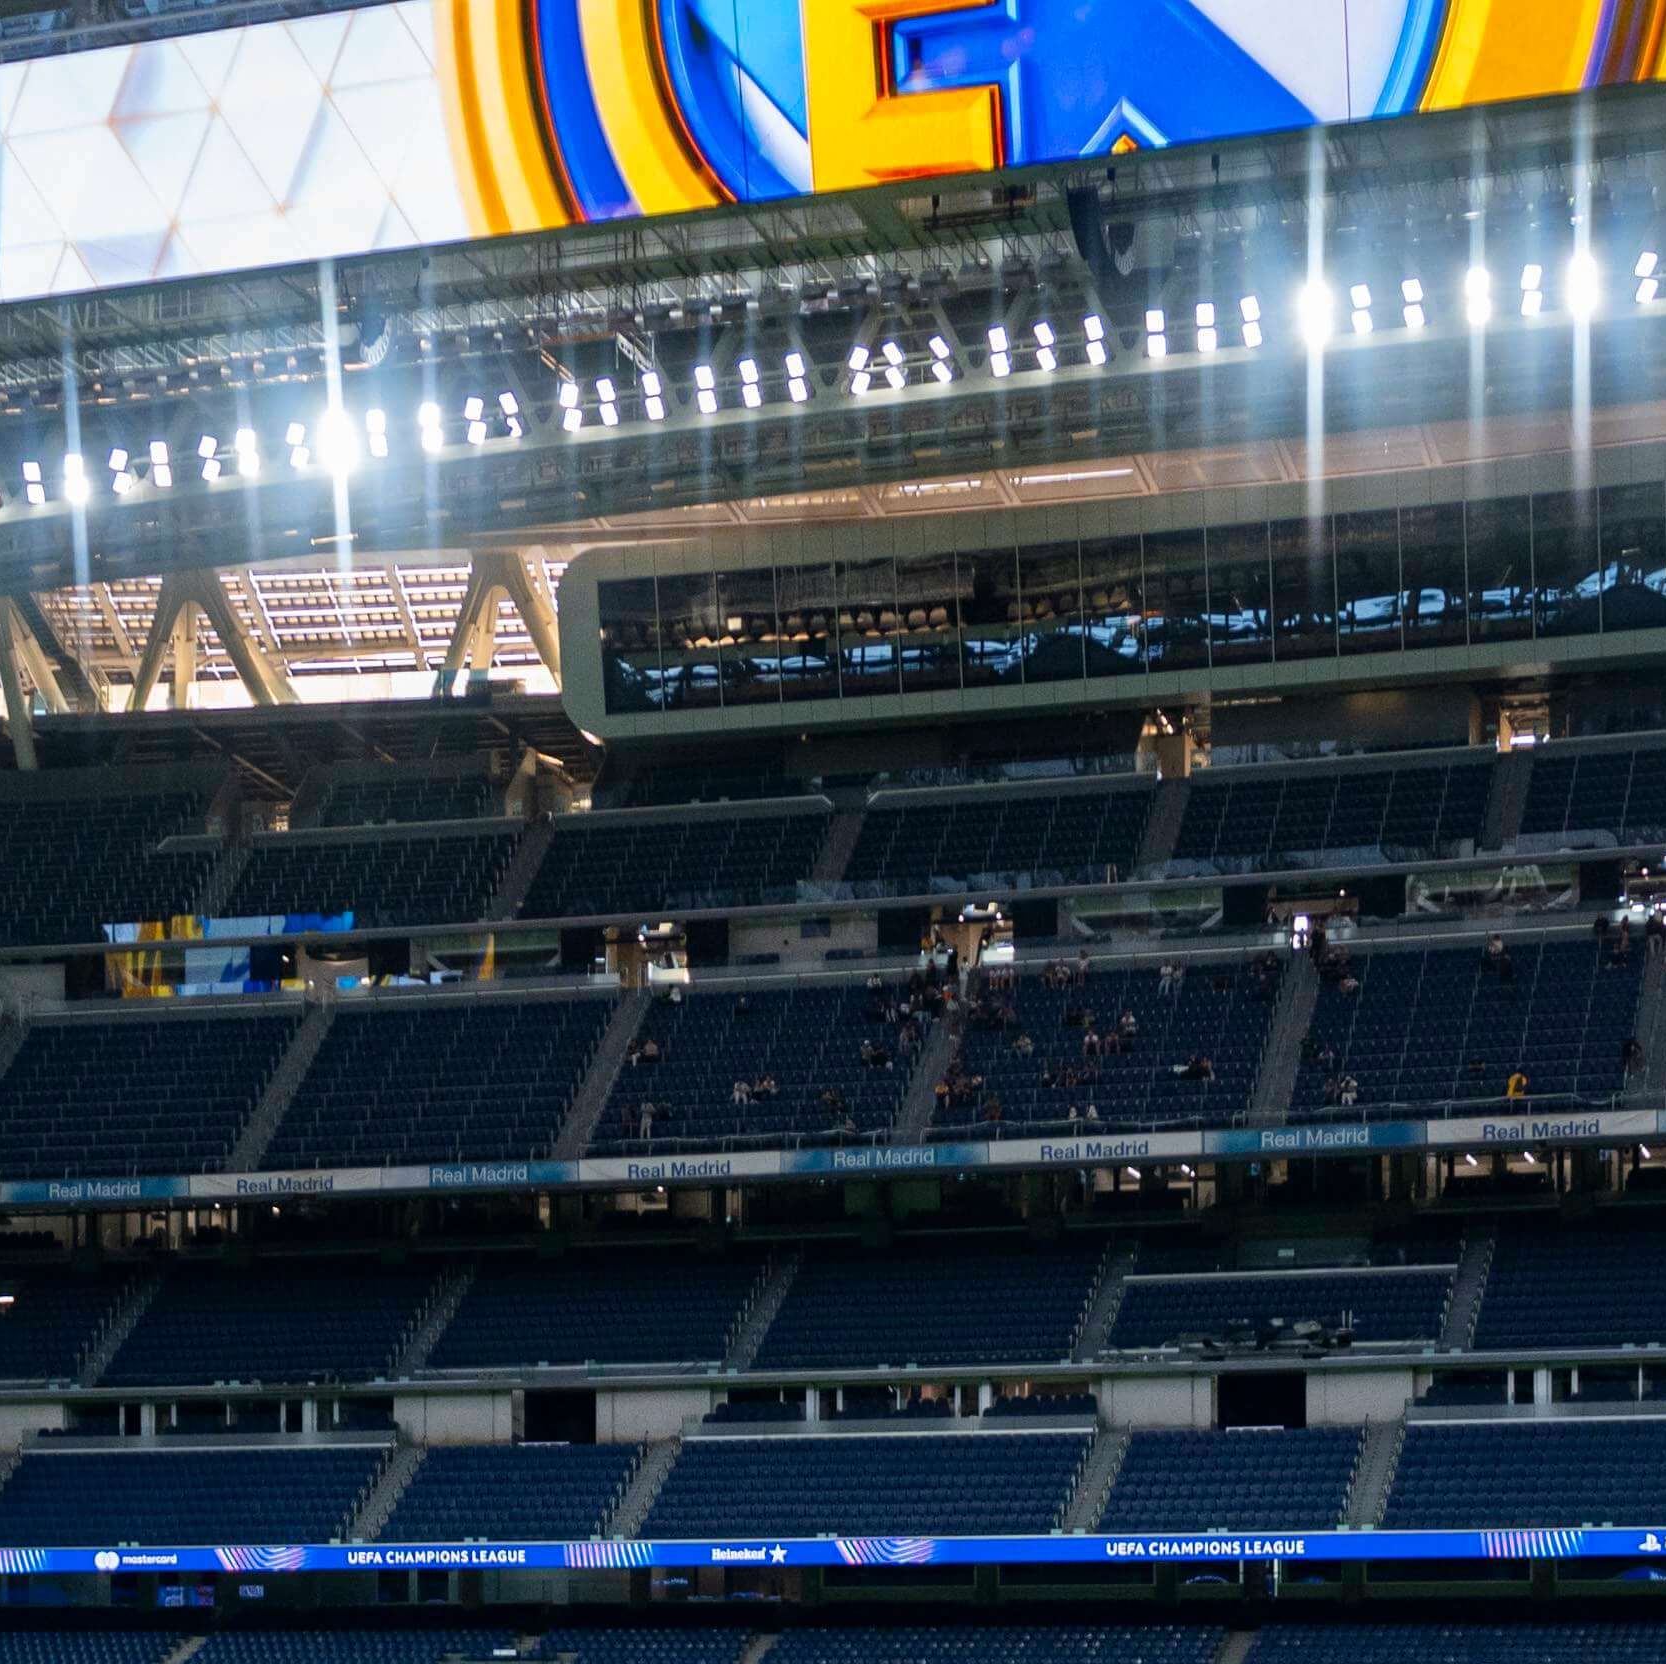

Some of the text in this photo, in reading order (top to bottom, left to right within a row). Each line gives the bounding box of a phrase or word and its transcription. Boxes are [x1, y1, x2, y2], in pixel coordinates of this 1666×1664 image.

[1260, 1127, 1370, 1149] Real Madrid
[1483, 1119, 1600, 1140] Real Madrid
[835, 1149, 933, 1169] Real Madrid
[1041, 1140, 1149, 1161] Real Madrid
[432, 1165, 528, 1183] Real Madrid
[628, 1160, 730, 1179] Real Madrid
[49, 1180, 141, 1199] Real Madrid
[237, 1175, 333, 1195] Real Madrid
[347, 1549, 527, 1564] UEFA CHAMPIONS LEAGUE
[711, 1547, 766, 1561] Heineken
[1106, 1540, 1305, 1556] UEFA CHAMPIONS LEAGUE
[122, 1553, 178, 1566] mastercard
